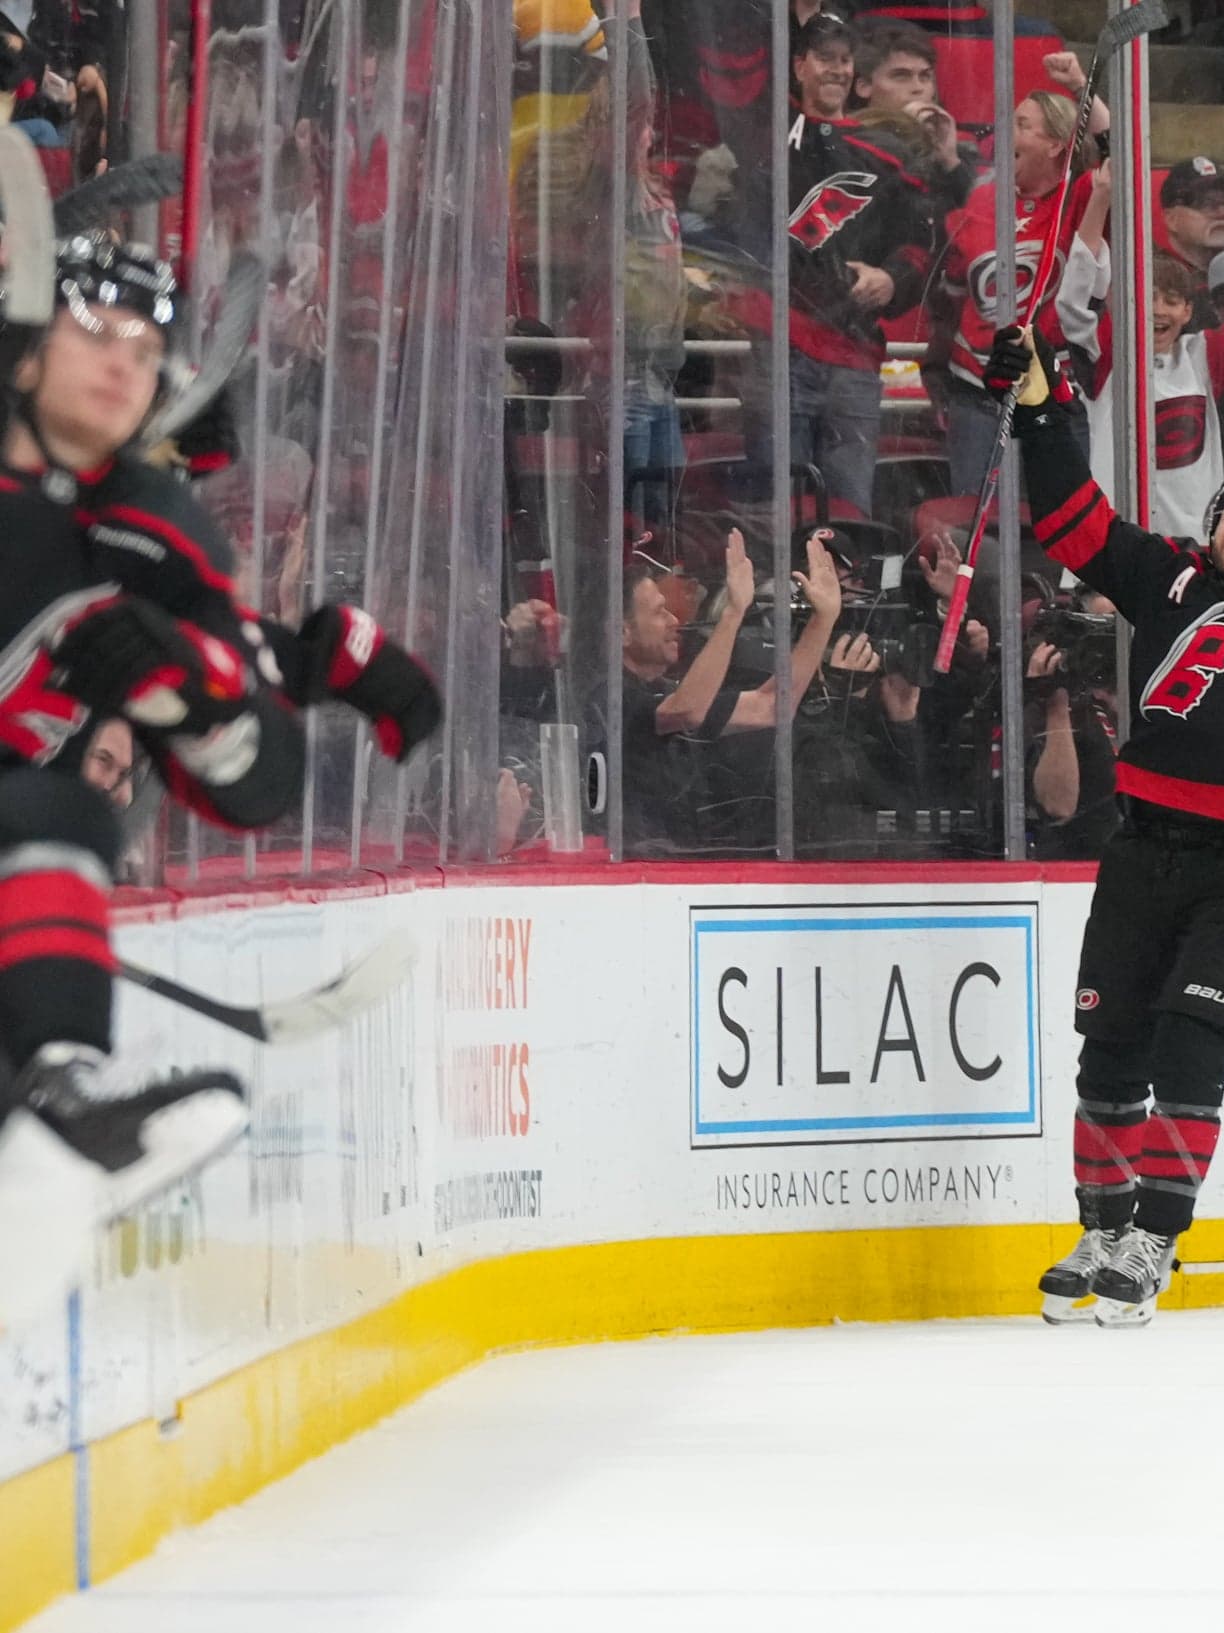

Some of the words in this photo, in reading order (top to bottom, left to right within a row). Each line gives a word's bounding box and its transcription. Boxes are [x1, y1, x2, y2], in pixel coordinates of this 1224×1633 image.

[788, 113, 805, 150] A
[1168, 566, 1196, 604] A
[716, 961, 1003, 1089] SILAC
[716, 1169, 850, 1210] INSURANCE
